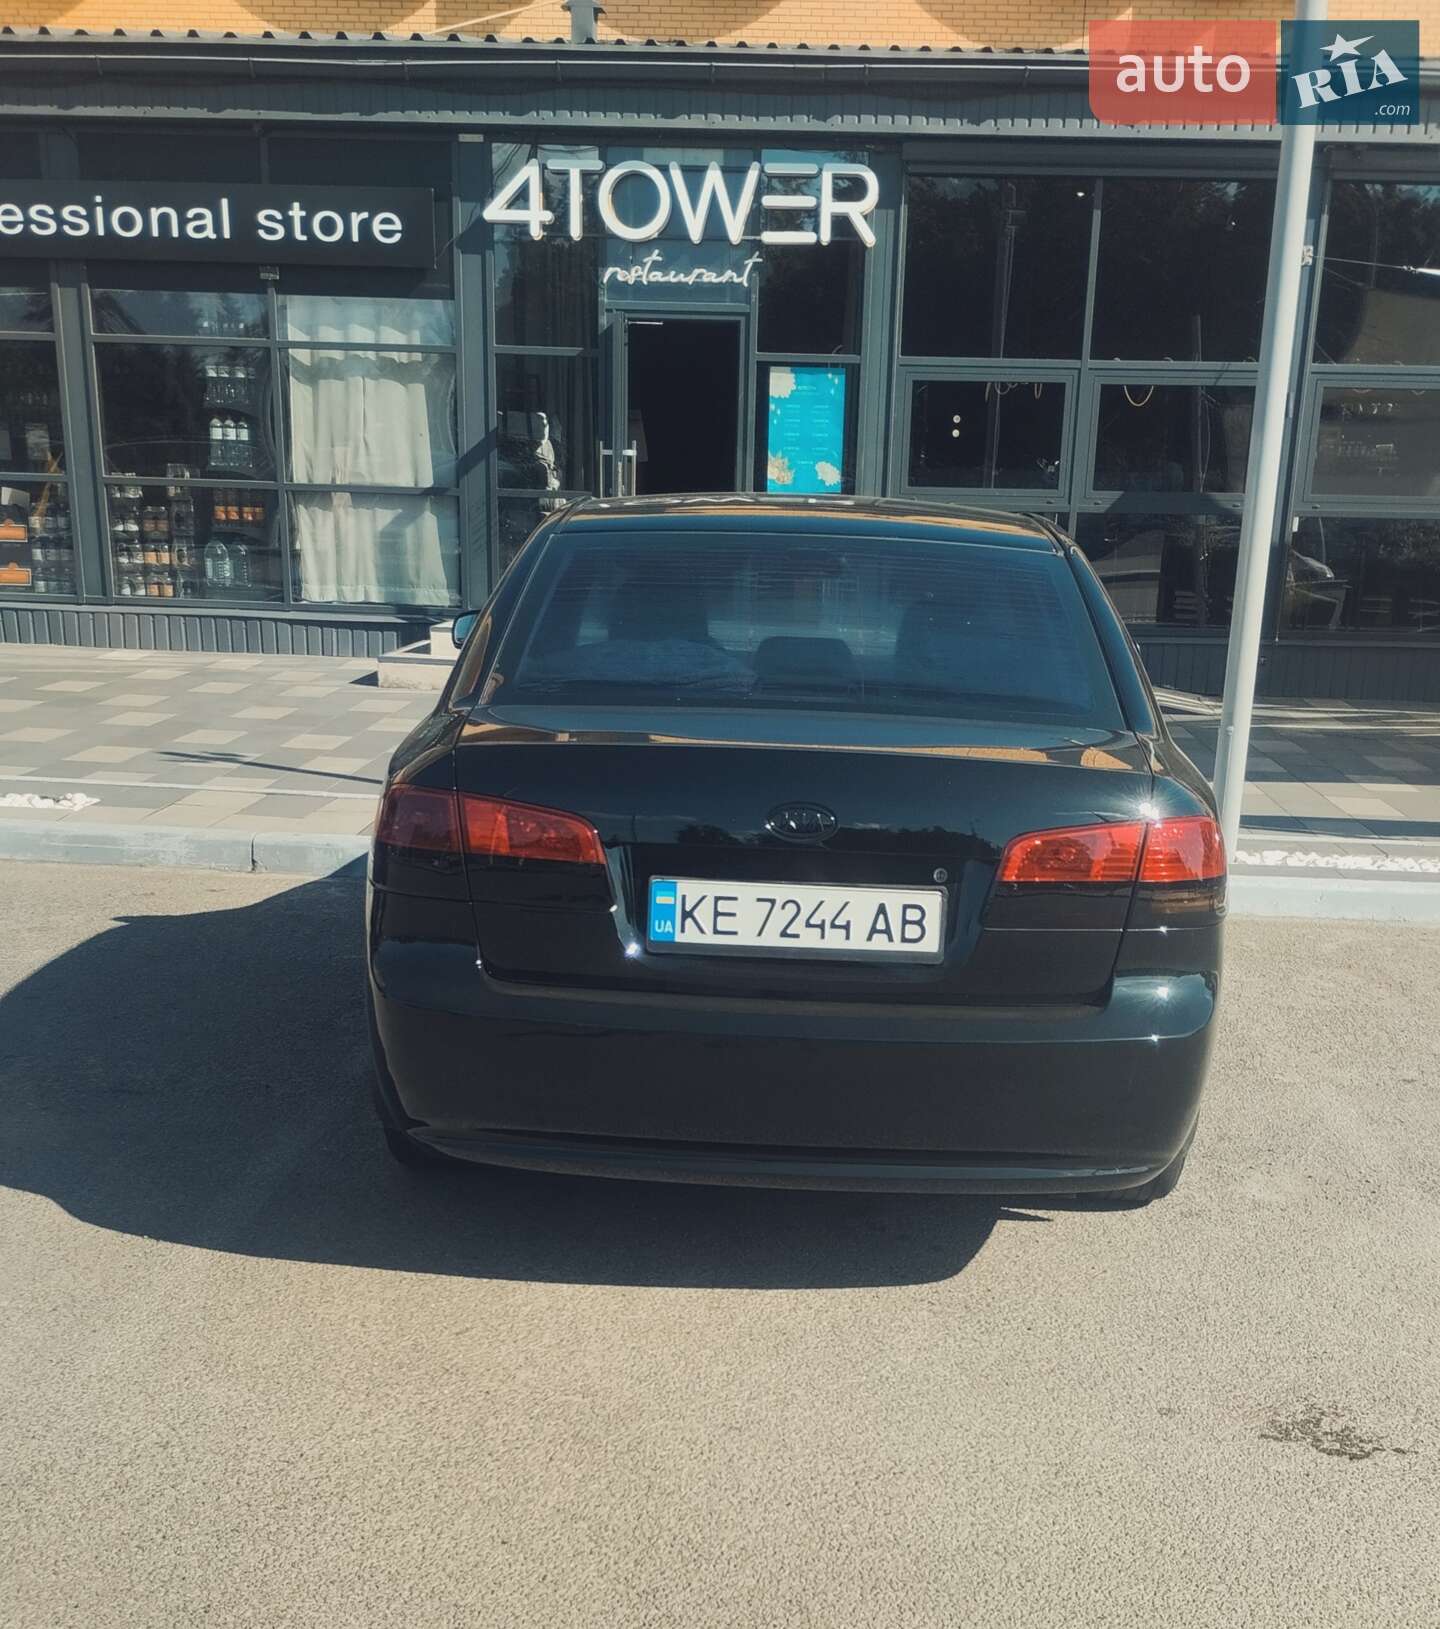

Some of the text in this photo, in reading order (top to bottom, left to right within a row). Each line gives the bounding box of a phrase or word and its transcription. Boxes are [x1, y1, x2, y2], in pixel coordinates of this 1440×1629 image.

[0, 195, 403, 244] essional store
[482, 158, 880, 248] 4TOWER
[602, 249, 763, 288] restaurant
[655, 920, 674, 933] UA
[680, 894, 926, 944] KE 7244 AB
